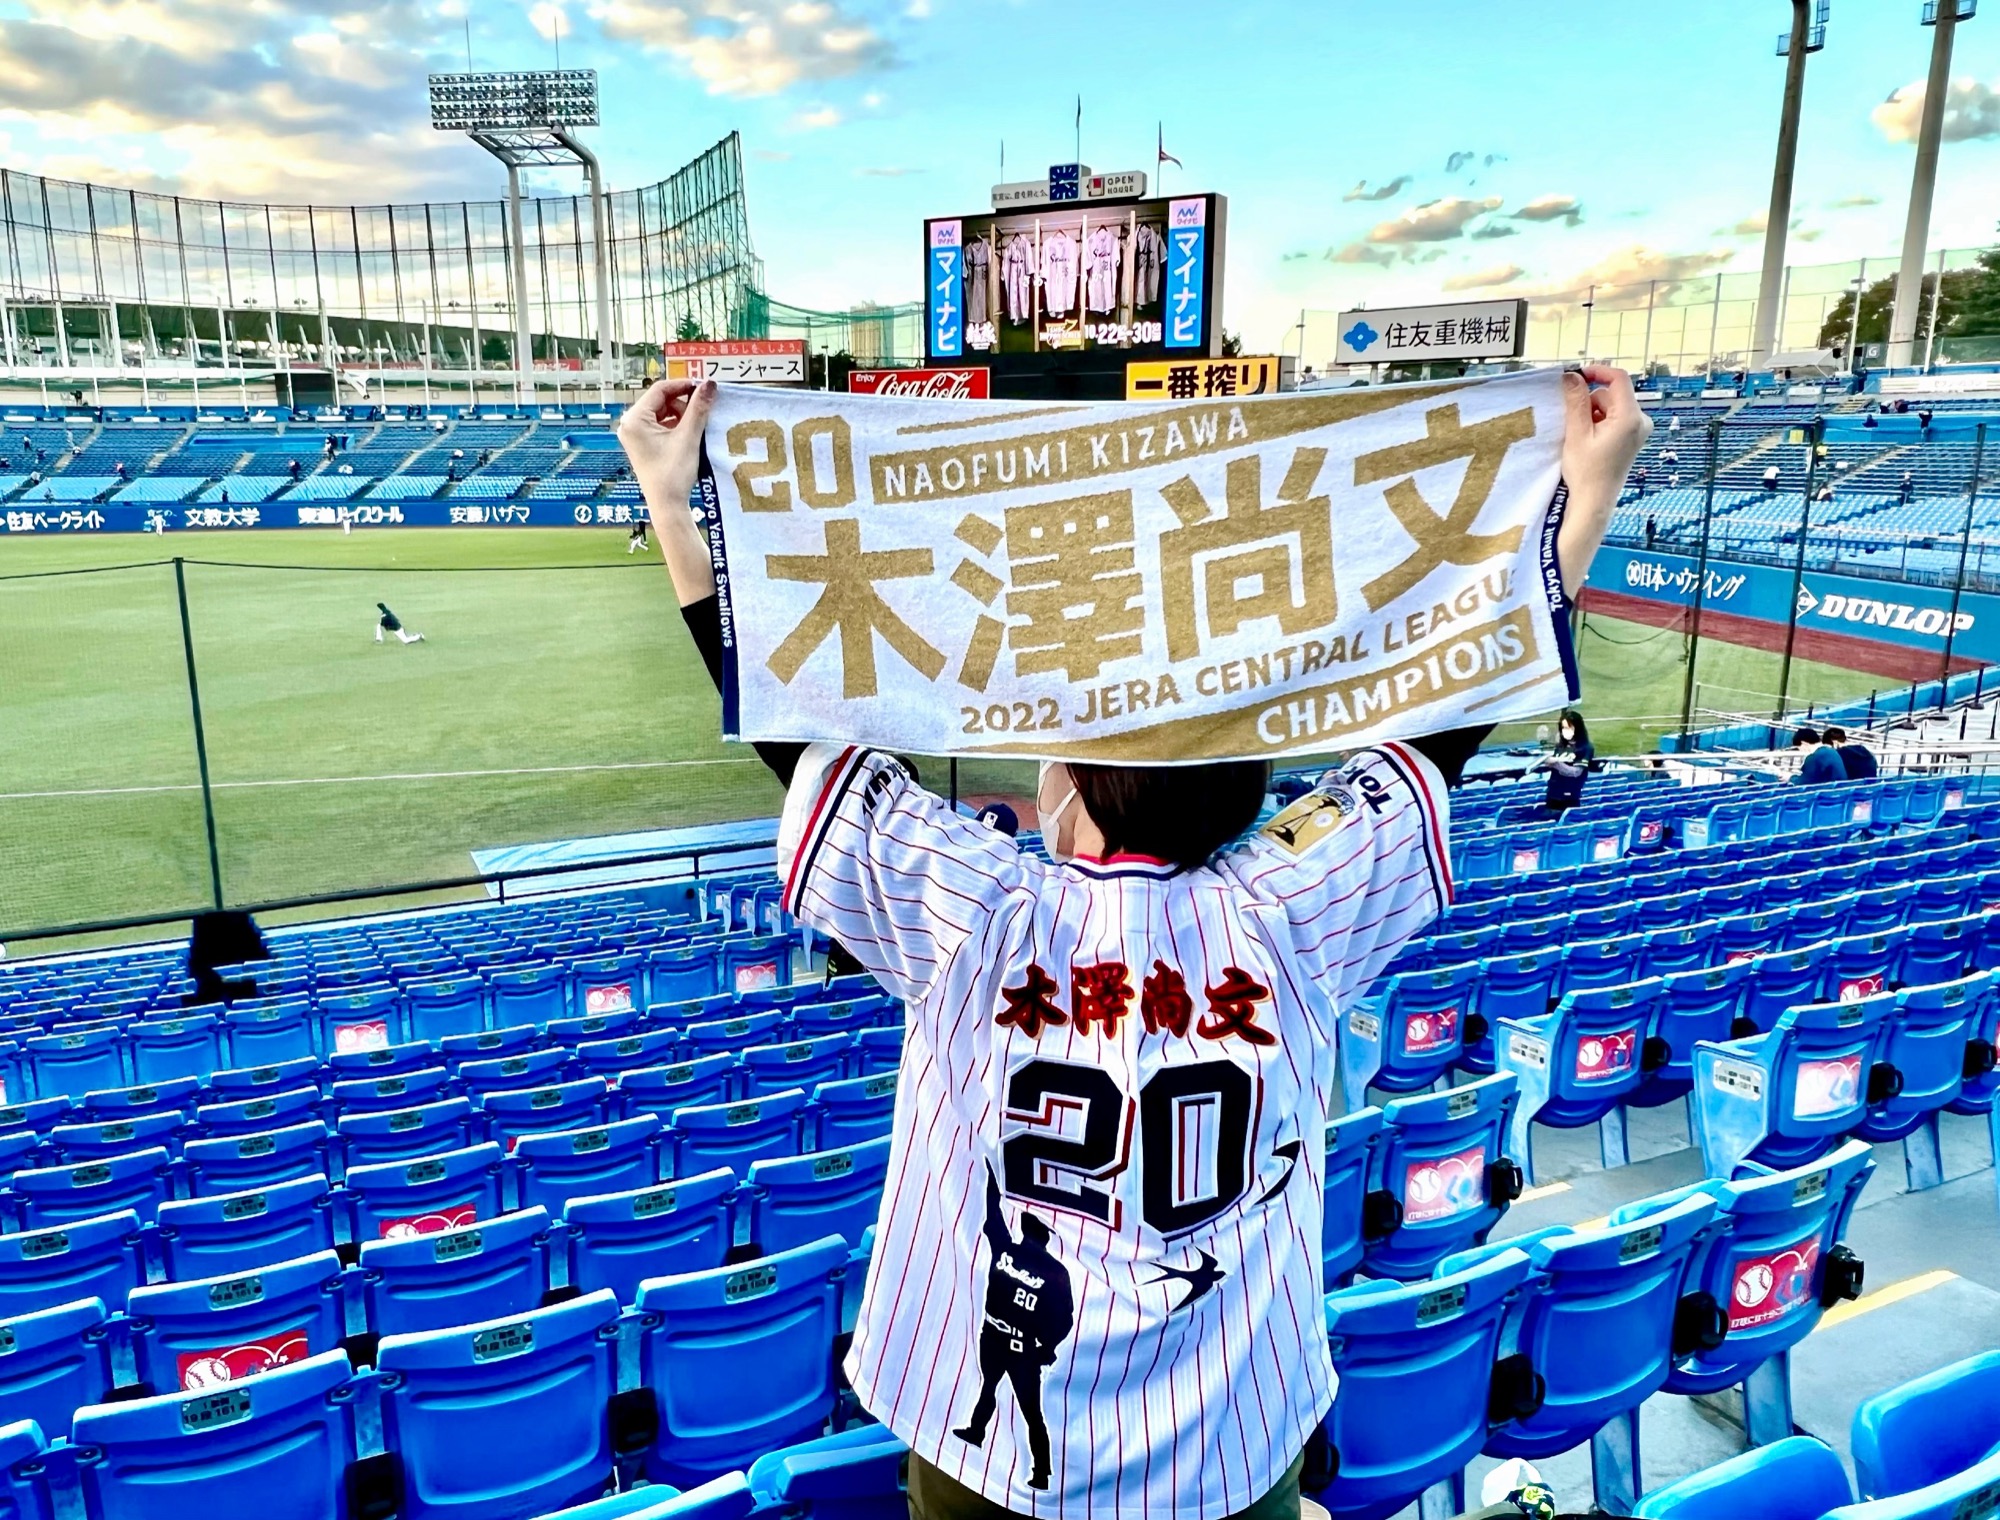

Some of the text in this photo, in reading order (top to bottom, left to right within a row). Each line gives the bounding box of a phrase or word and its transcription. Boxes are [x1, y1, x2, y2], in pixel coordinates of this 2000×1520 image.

[1107, 176, 1134, 186] OPEN
[935, 251, 957, 352] マイナビ
[1173, 232, 1200, 341] マイナビ
[1385, 315, 1511, 349] 住友重機械
[1869, 347, 1877, 356] G
[707, 359, 801, 377] フージャース
[856, 373, 876, 384] Enjoy
[876, 372, 974, 400] Coca-Cola
[1135, 363, 1268, 399] 一番搾り
[727, 414, 858, 513] 20
[884, 406, 1249, 499] NAOFUMI KIZAWA
[184, 507, 261, 527] 文教大学
[449, 505, 530, 523] 安藤ハザマ
[701, 475, 733, 648] Tokyo Yakult Swallows
[765, 402, 1537, 699] 木澤尚文
[1541, 482, 1569, 613] Tokyo Yakult Swall
[1817, 593, 1976, 638] DUNLOP
[960, 697, 1063, 734] 2022
[1075, 674, 1182, 723] JERA
[1195, 630, 1370, 697] CENTRAL
[1256, 622, 1527, 745] CHAMPIONS
[1342, 765, 1393, 815] Tok
[995, 958, 1280, 1047] 木澤尚文
[999, 1055, 1265, 1243] 20
[1013, 1287, 1038, 1312] 20
